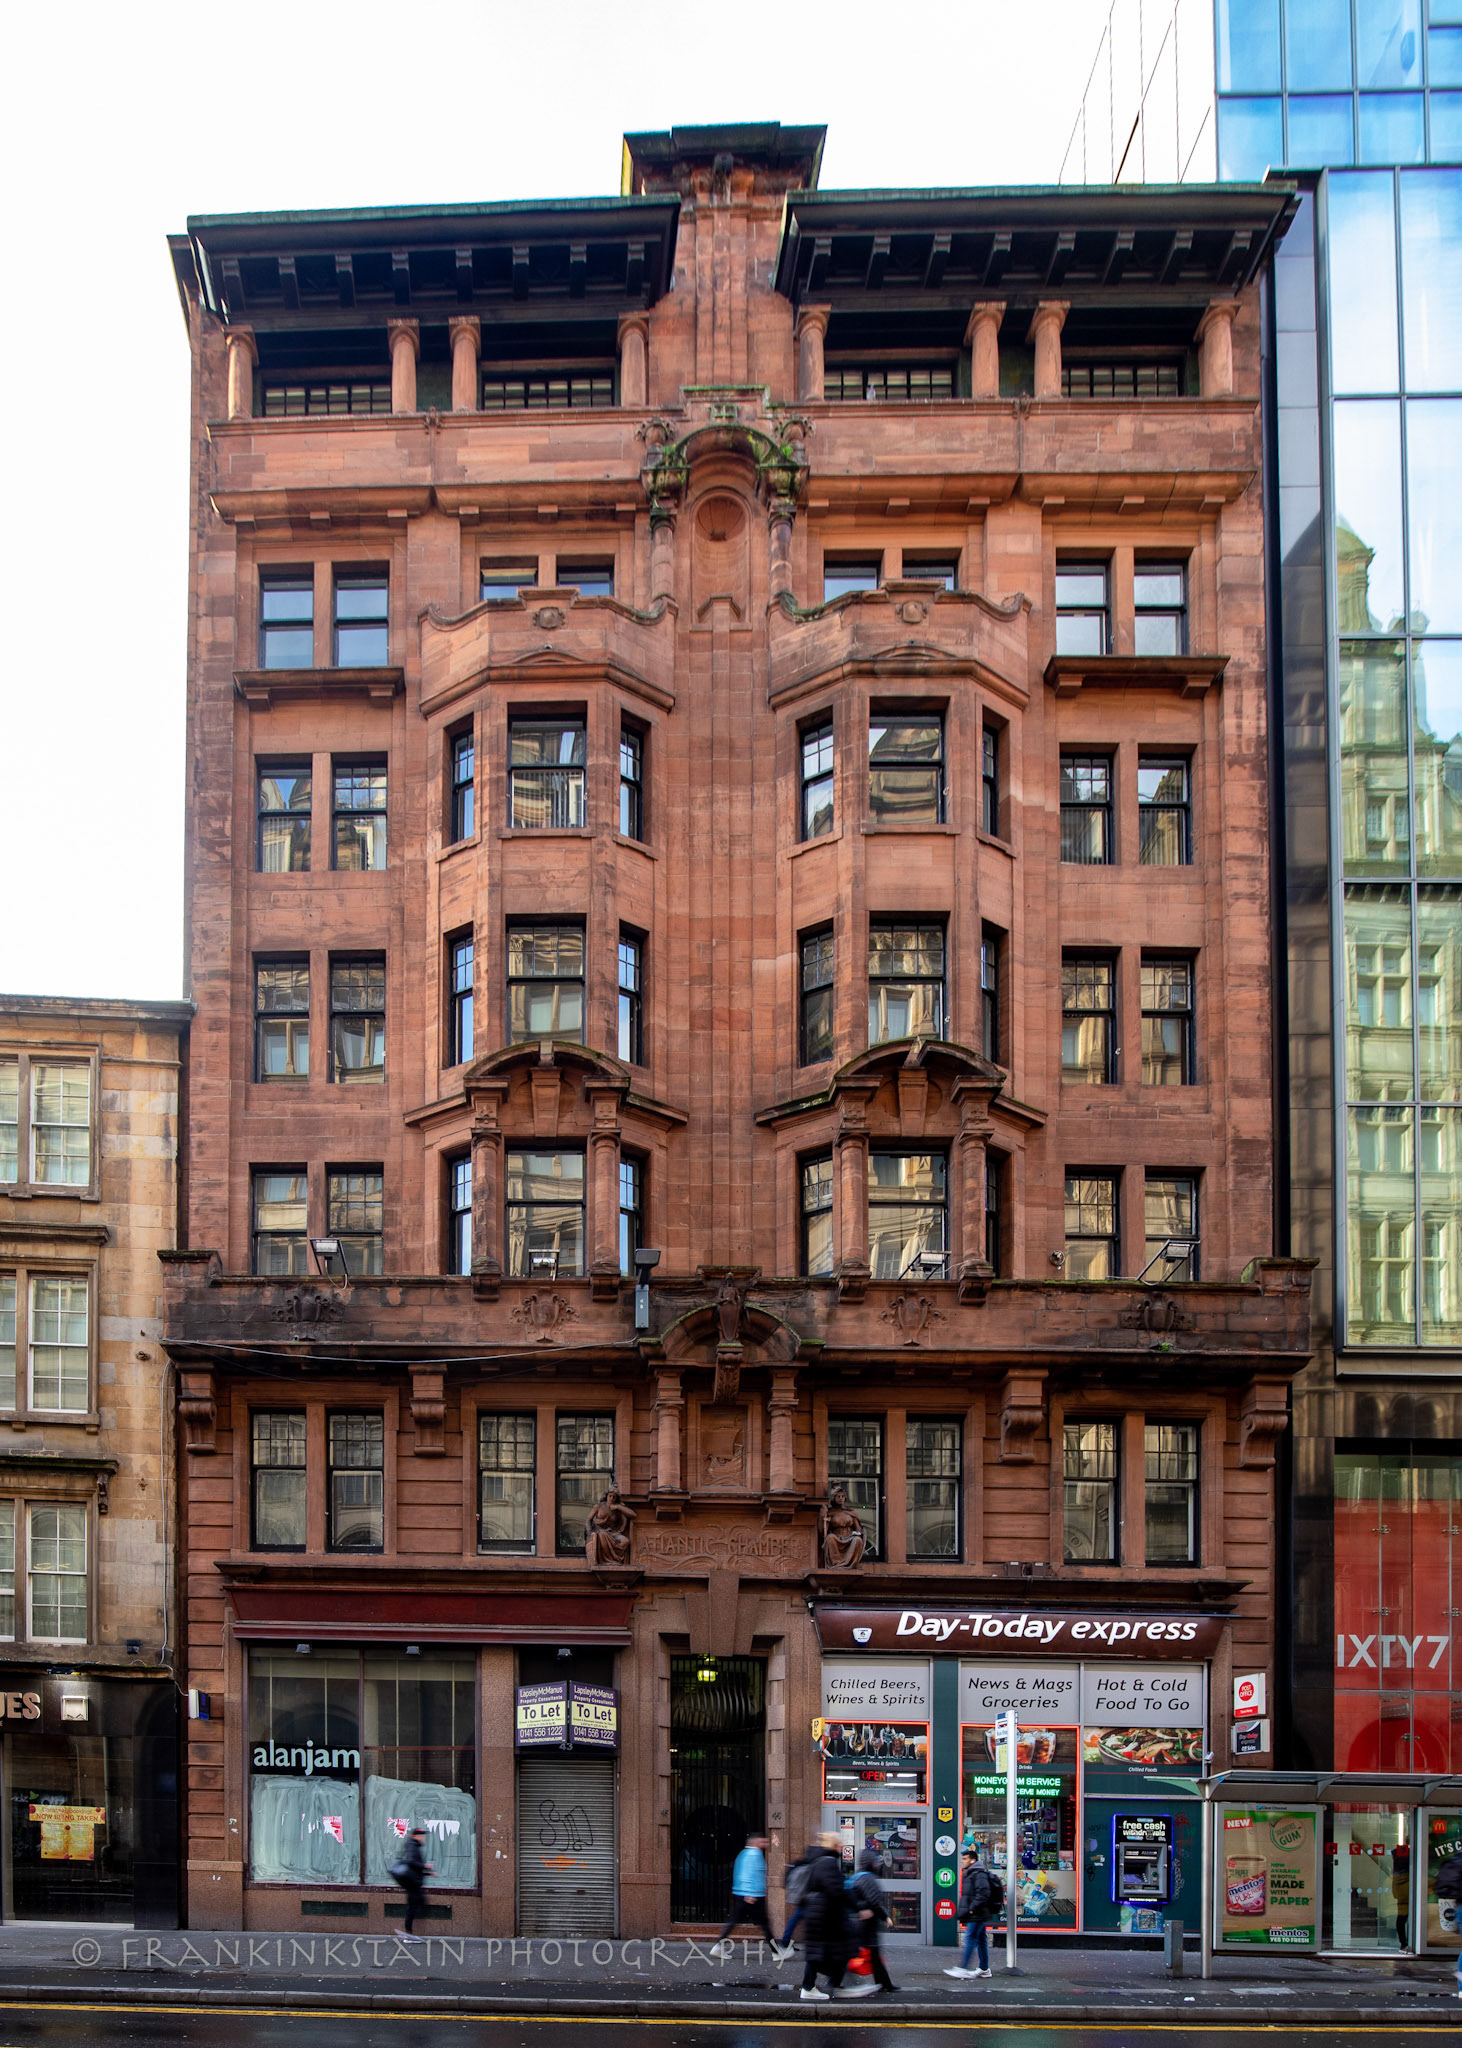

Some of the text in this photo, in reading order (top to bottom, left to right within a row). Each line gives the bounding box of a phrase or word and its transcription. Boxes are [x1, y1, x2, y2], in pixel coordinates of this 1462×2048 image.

[641, 1536, 809, 1557] ATLANTIC CHAMBERS
[896, 1611, 1198, 1645] Day-Today express
[1337, 1634, 1449, 1669] IXTY7
[831, 1679, 921, 1691] Chilled Beers,
[968, 1677, 1073, 1693] News & Mags
[1097, 1678, 1187, 1692] Hot & Cold
[520, 1686, 562, 1698] LapsleyMcManus
[574, 1685, 614, 1699] LapsleyMcManus
[826, 1694, 925, 1706] Wines & Spirits
[982, 1695, 1059, 1709] Groceries
[1096, 1698, 1190, 1711] Food To Go
[523, 1704, 560, 1719] To Let
[577, 1704, 612, 1721] To Let
[520, 1728, 533, 1737] 0141
[548, 1727, 562, 1736] 1222
[574, 1727, 614, 1740] 0141 556 1222
[559, 1743, 573, 1751] 43
[254, 1740, 360, 1775] alanjam
[862, 1771, 886, 1781] OPEN
[974, 1776, 1060, 1786] MONEYGAM SERVICE
[1123, 1821, 1165, 1830] free cash
[1227, 1819, 1250, 1828] NEW
[1280, 1831, 1301, 1845] GUM
[1435, 1843, 1454, 1856] IT'S
[1229, 1877, 1265, 1896] mentos
[1271, 1880, 1304, 1889] MADE
[1270, 1929, 1309, 1937] mentos
